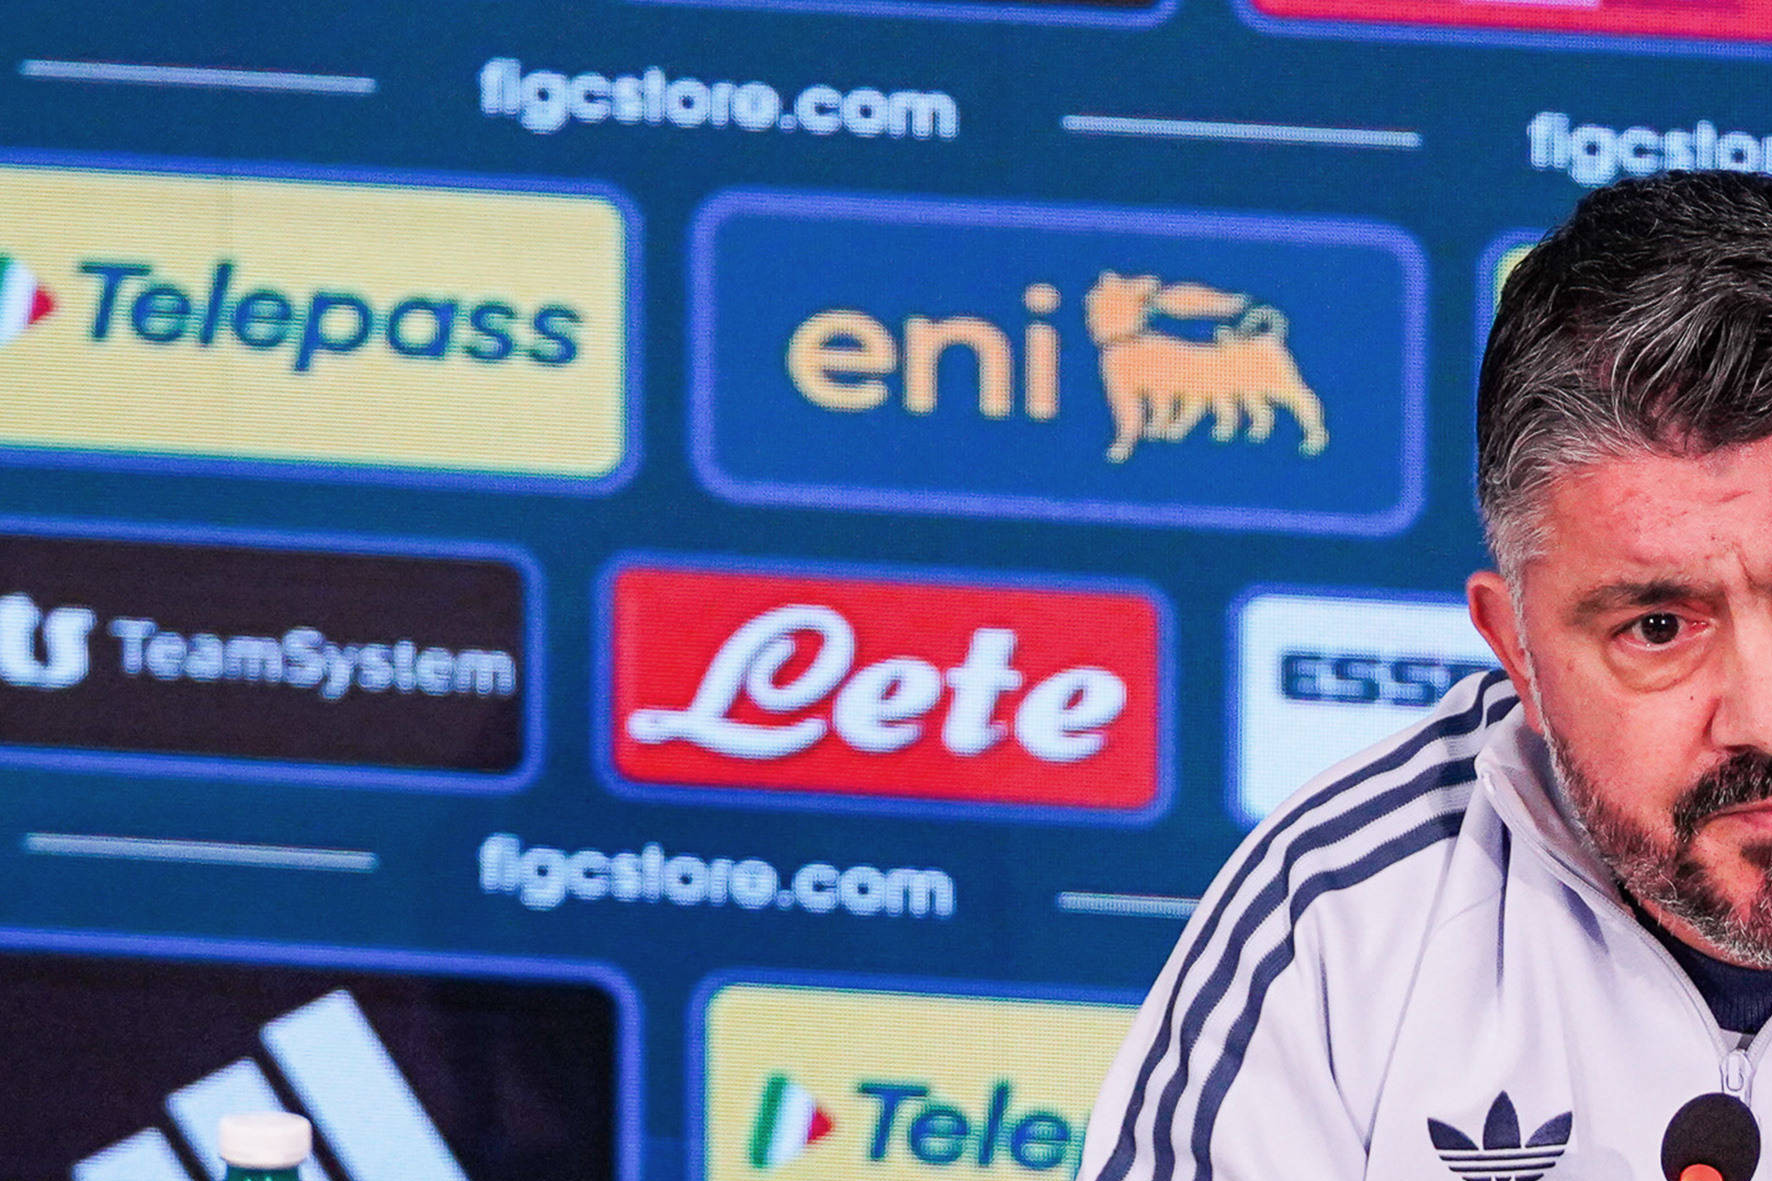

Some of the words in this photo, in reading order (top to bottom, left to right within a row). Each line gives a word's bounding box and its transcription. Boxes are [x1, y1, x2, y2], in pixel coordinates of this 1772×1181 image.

[479, 57, 960, 140] figcstore.com
[79, 260, 583, 372] Telepass
[786, 283, 1062, 421] eni
[108, 616, 516, 700] TeamSystem
[627, 605, 1127, 763] Lete
[478, 833, 956, 921] figcstore.com
